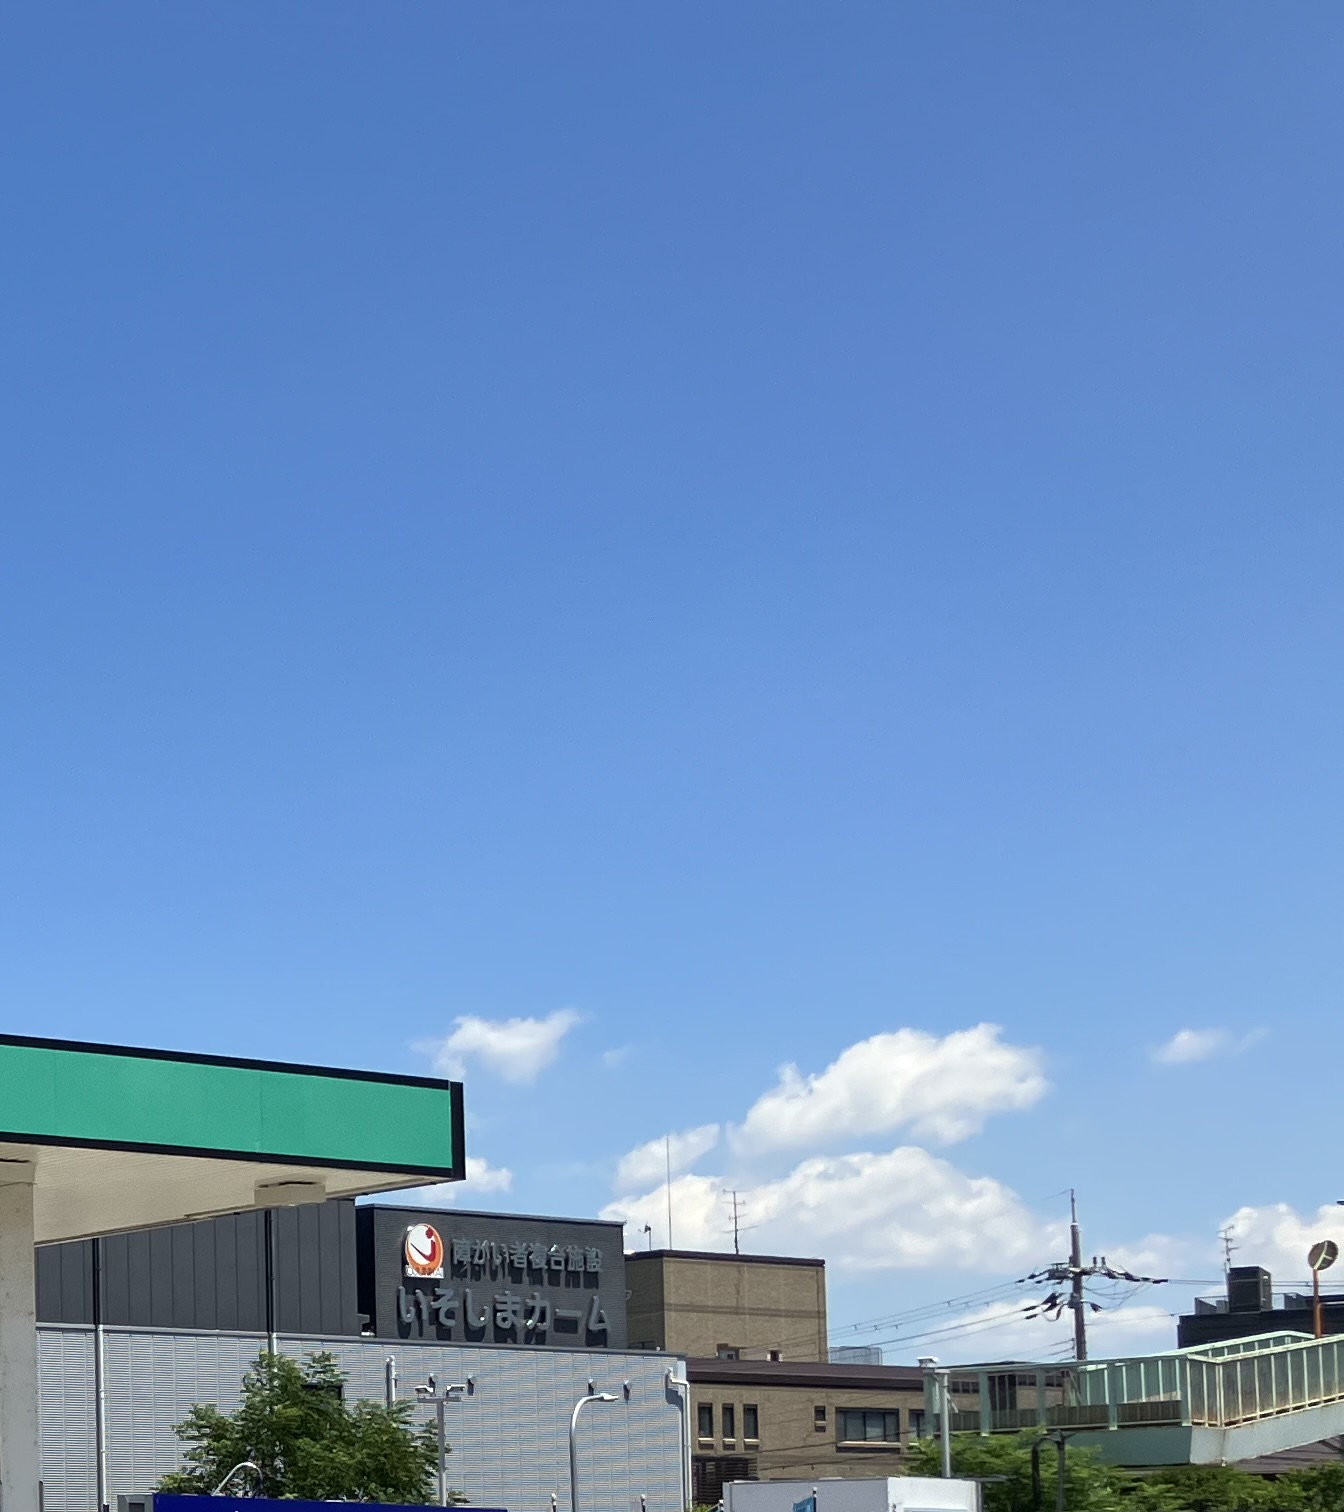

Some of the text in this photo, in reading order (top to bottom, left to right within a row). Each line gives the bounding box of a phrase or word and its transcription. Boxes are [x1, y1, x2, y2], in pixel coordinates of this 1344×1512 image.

[398, 1285, 611, 1332] いそしまカーム
